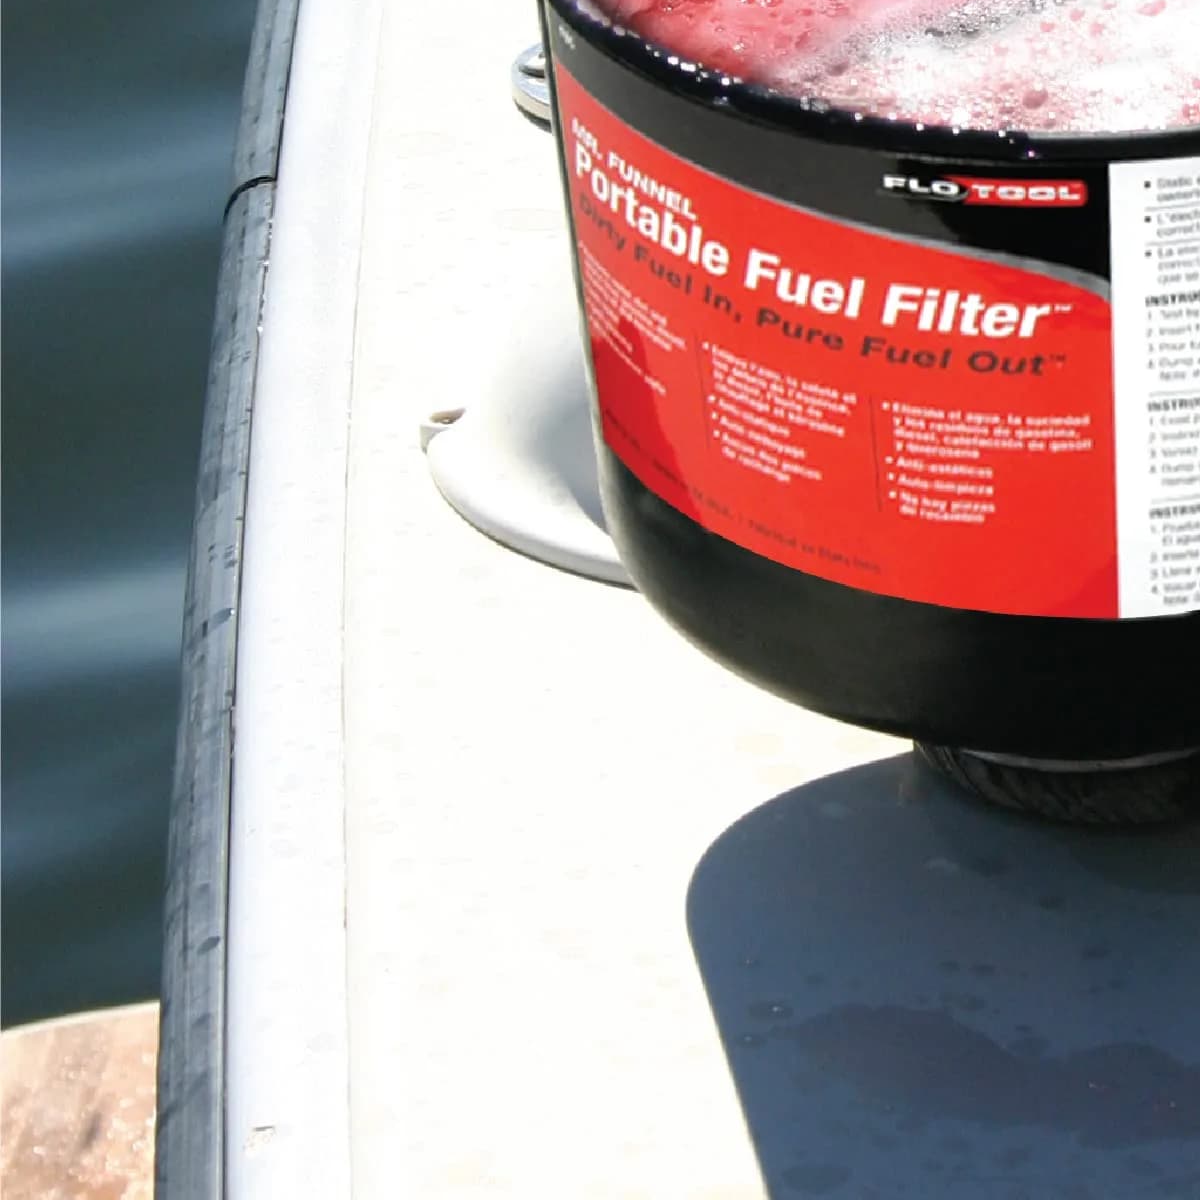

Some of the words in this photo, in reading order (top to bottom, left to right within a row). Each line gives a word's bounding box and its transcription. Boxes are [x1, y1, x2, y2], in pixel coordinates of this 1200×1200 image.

[575, 140, 730, 276] Portable
[744, 247, 866, 320] Fuel
[608, 151, 698, 221] FUNNEL
[634, 243, 692, 295] Fuel
[756, 306, 844, 351] Pure
[861, 335, 952, 369] Fuel
